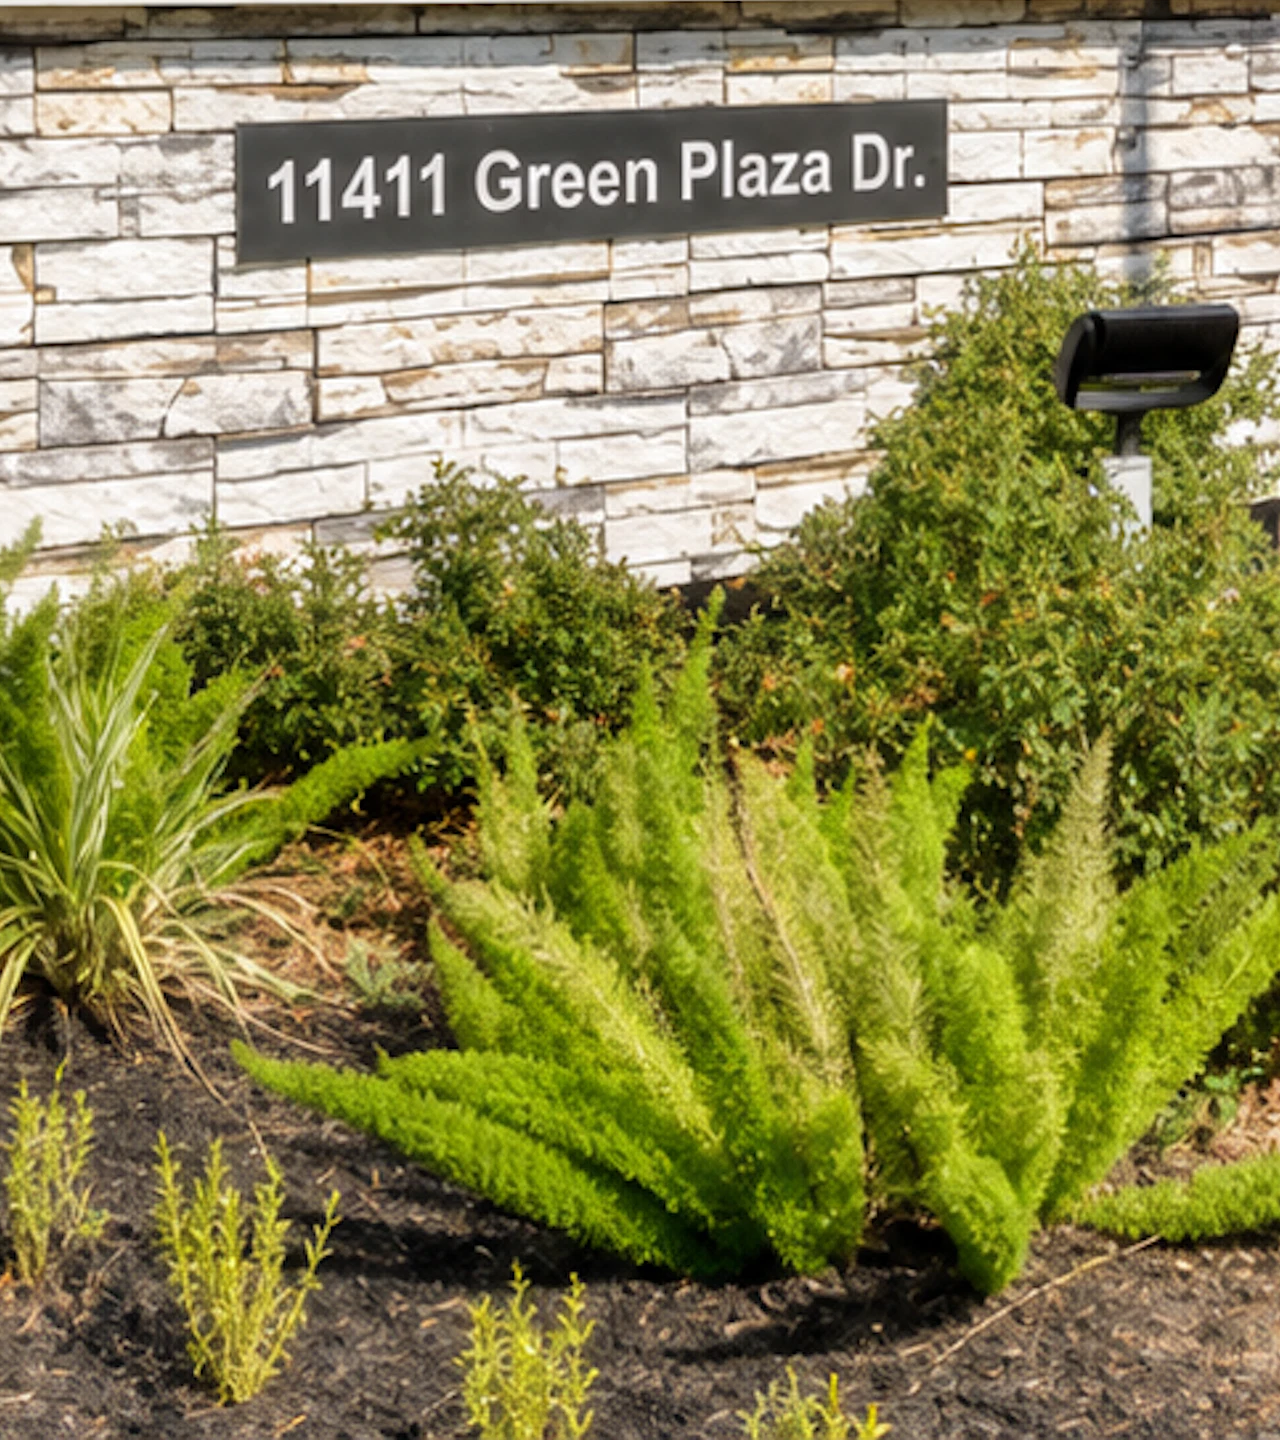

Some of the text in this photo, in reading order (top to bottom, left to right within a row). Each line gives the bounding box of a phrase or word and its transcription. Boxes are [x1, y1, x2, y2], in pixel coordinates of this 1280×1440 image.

[269, 134, 924, 223] 11411 Green Plaza Dr.
